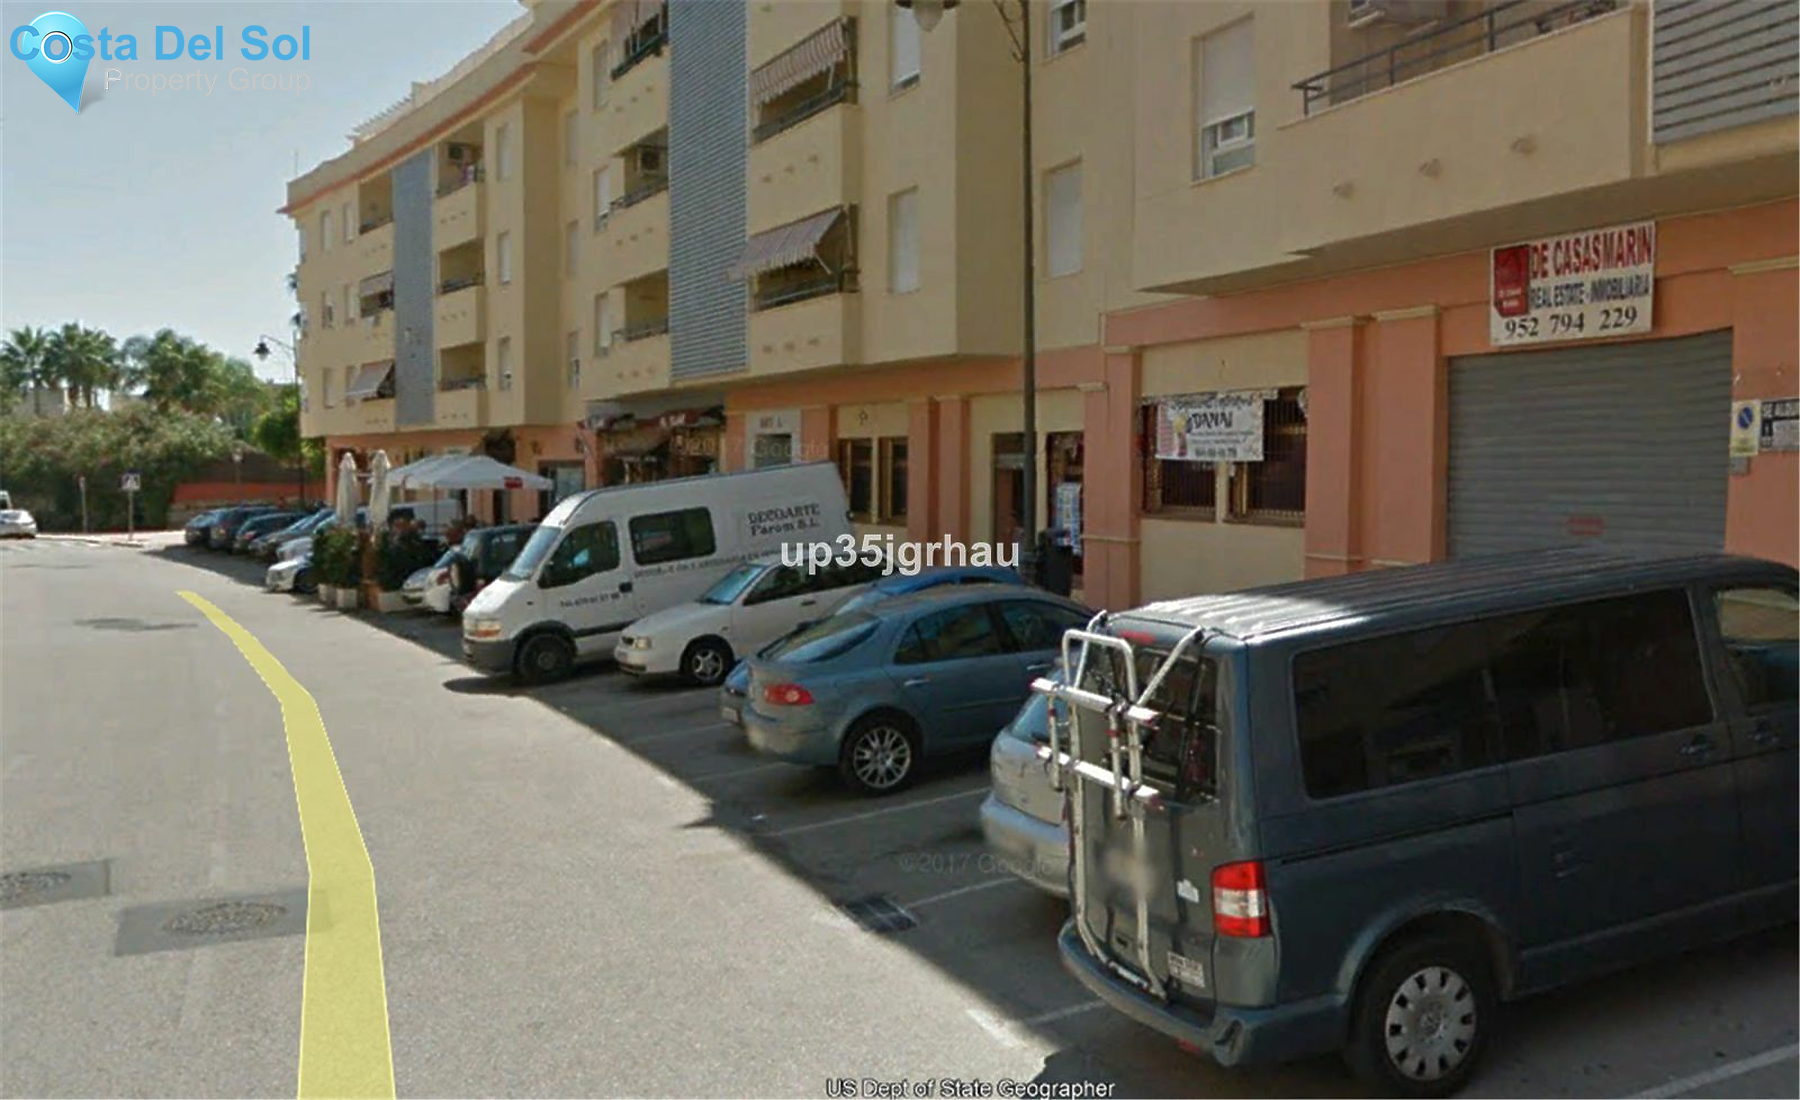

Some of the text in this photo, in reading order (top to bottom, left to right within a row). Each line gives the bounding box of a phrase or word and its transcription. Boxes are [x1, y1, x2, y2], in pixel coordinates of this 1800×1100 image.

[1531, 241, 1549, 280] DE
[1530, 286, 1551, 309] REAL
[1554, 281, 1584, 306] ESTATE
[1504, 305, 1638, 339] 952 794 229
